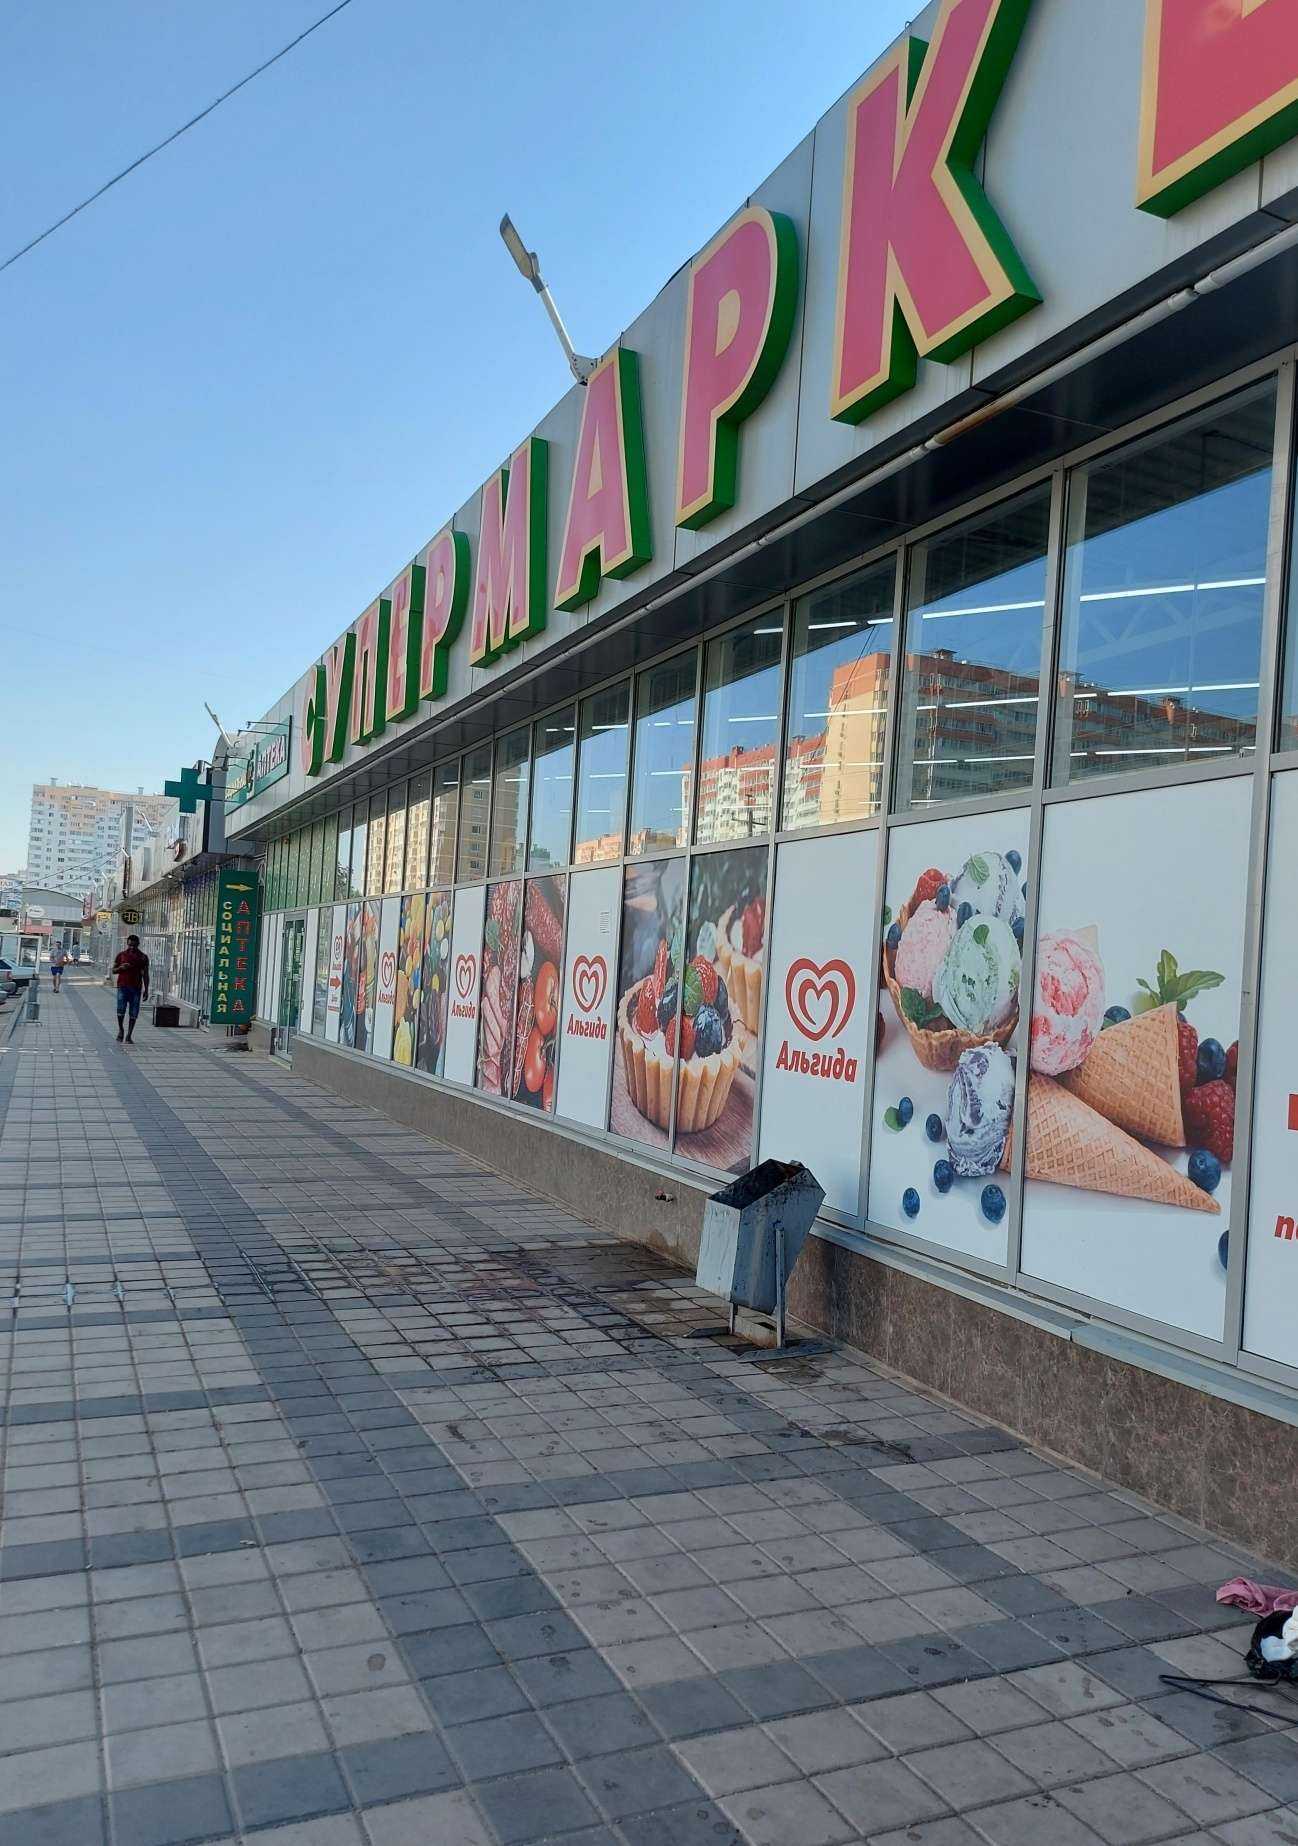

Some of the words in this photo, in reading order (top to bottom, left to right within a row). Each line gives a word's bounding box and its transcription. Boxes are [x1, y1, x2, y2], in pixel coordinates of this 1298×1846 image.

[216, 901, 233, 1013] СОЦИАЛЬНАЯ
[232, 900, 251, 1012] АПТЕКА
[567, 1013, 608, 1040] Альгида
[776, 1040, 858, 1083] Альгида
